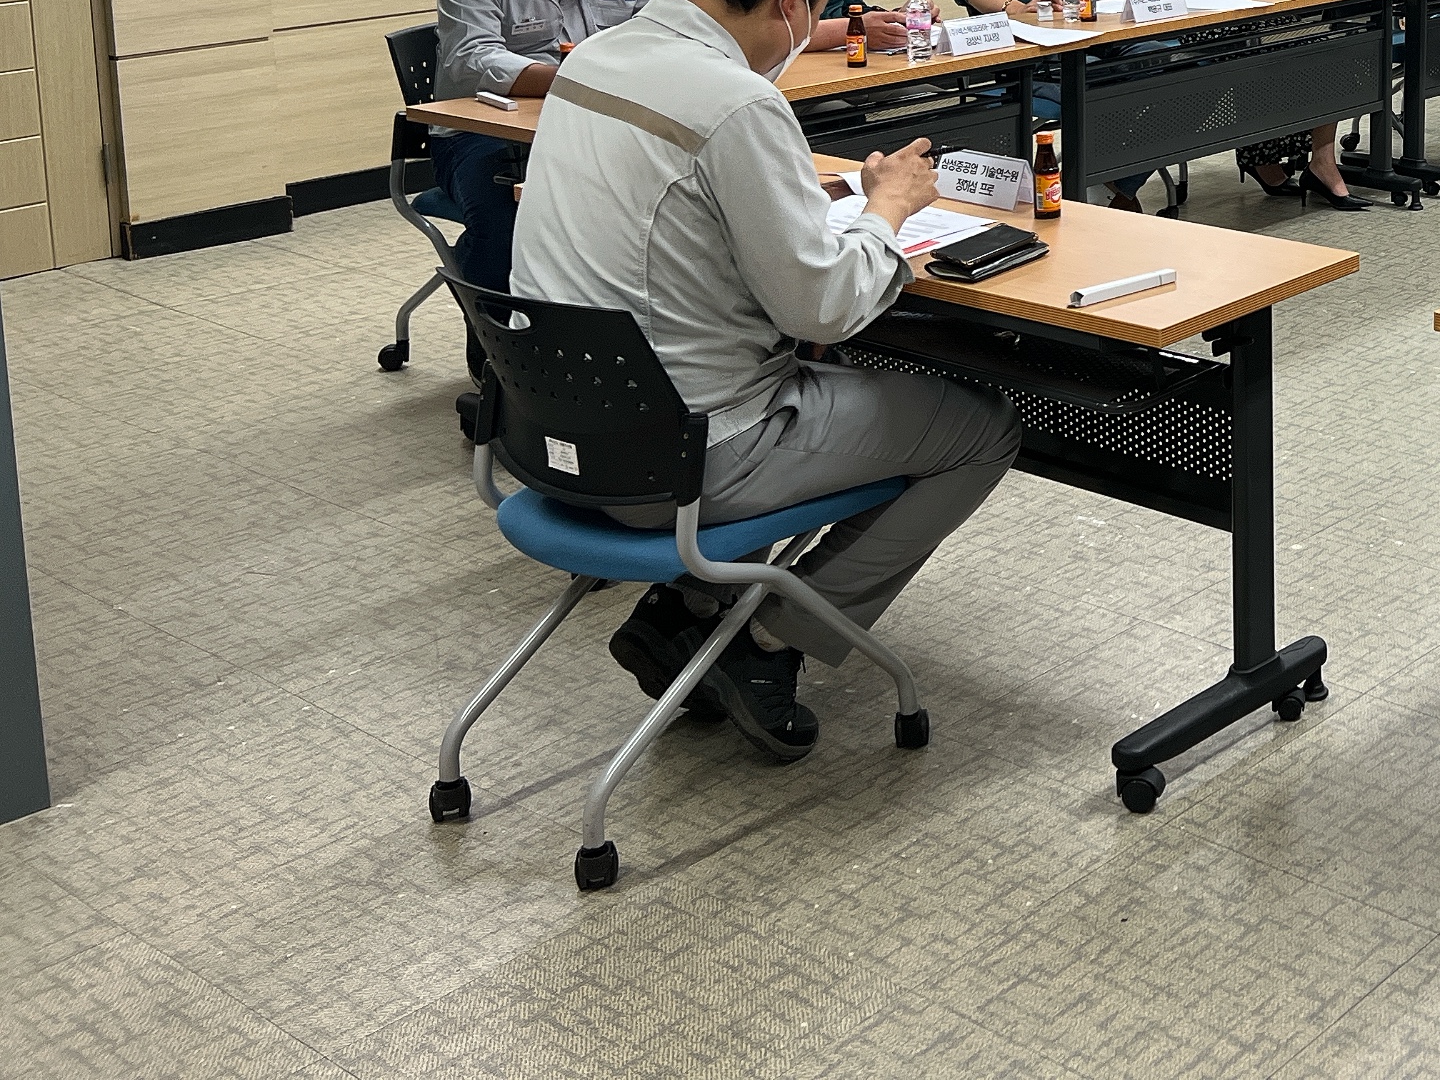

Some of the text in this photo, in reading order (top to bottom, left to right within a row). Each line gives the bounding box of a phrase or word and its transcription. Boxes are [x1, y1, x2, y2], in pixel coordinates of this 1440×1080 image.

[941, 158, 1020, 183] 삼성중공업 기술연수원
[978, 182, 995, 197] 프로
